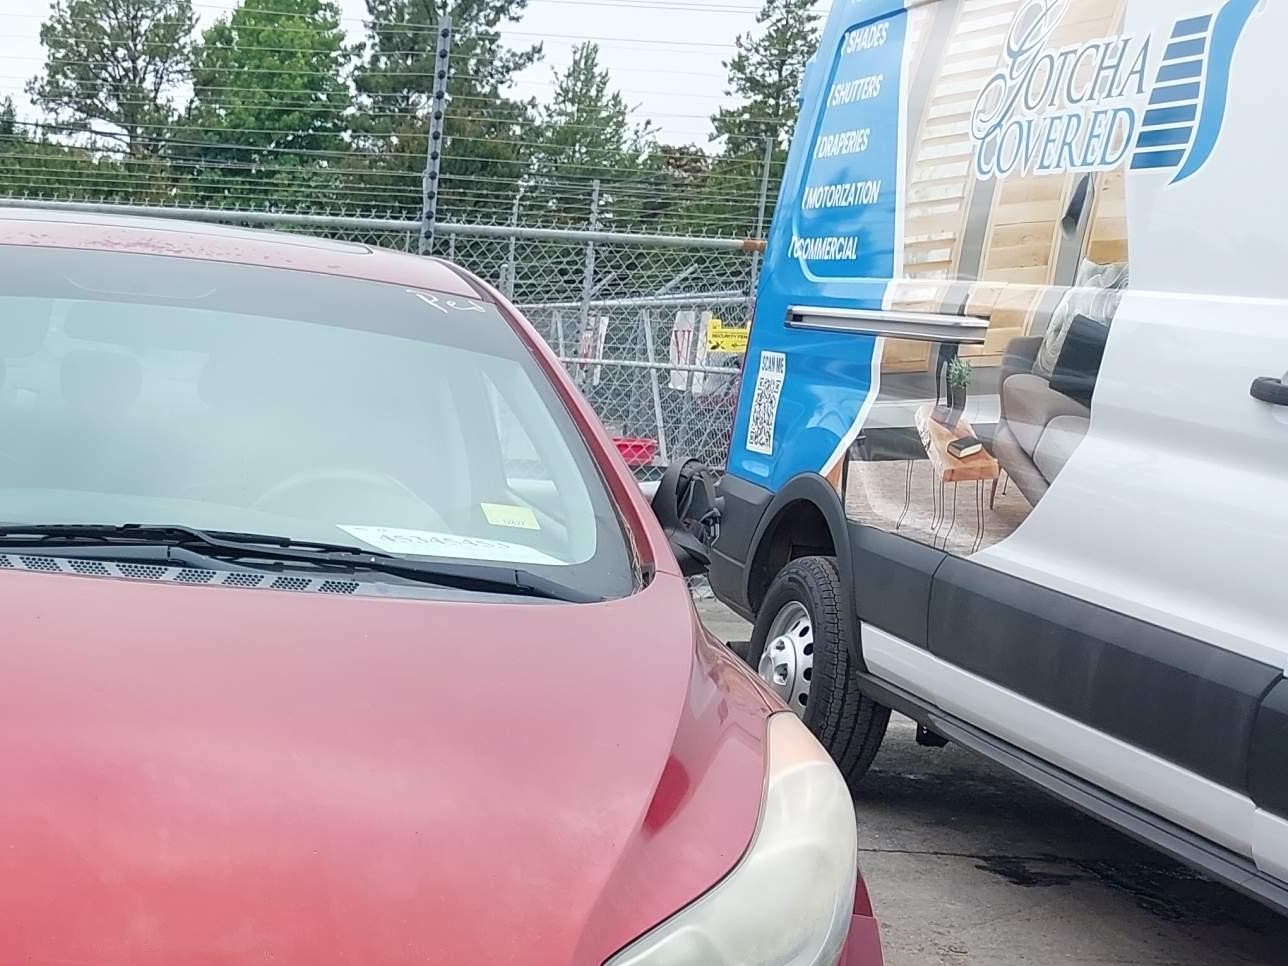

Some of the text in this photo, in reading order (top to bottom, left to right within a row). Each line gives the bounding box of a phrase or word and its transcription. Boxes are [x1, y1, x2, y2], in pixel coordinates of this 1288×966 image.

[971, 0, 1152, 140] GOTCHA
[976, 106, 1136, 176] COVERED
[761, 355, 776, 372] SCAN
